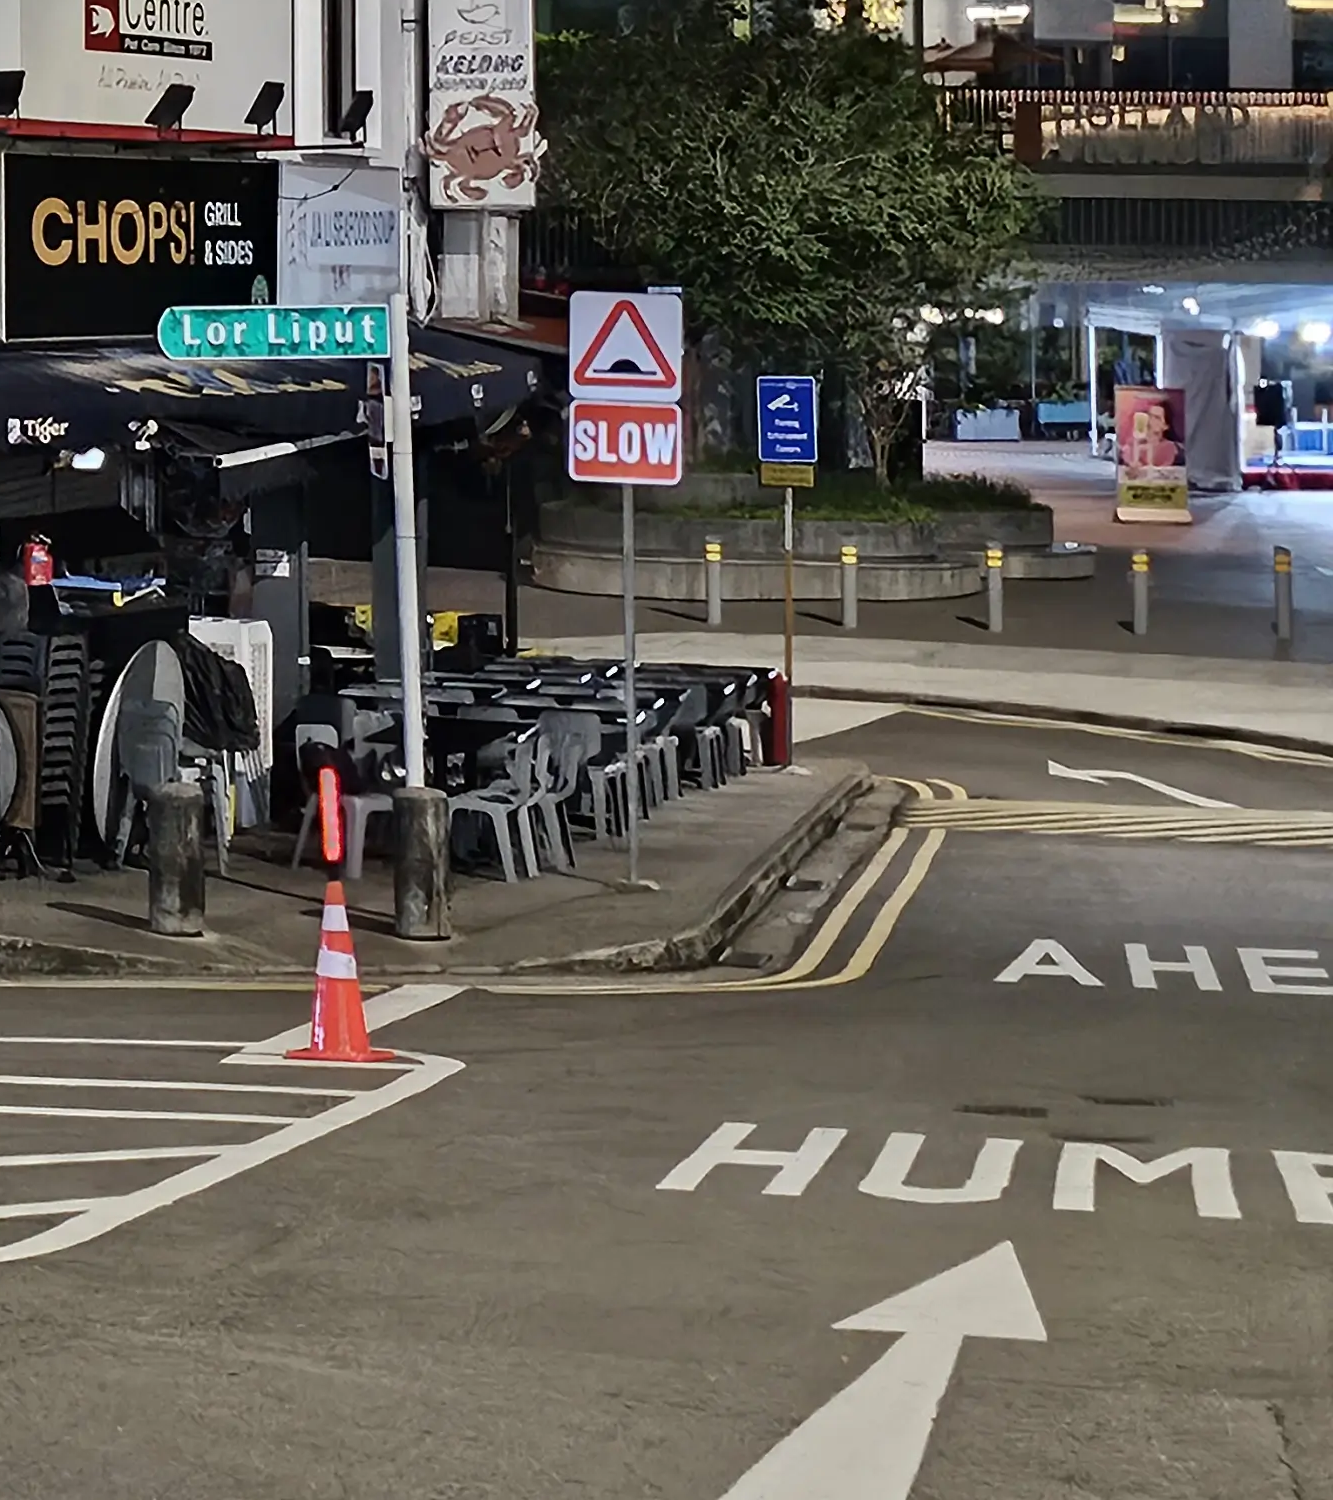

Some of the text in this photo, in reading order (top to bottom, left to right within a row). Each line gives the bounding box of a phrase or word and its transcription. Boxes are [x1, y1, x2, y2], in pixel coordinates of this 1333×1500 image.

[204, 202, 242, 226] GRILL
[31, 197, 195, 266] CHOPS!
[204, 240, 254, 266] & SIDES
[183, 312, 376, 351] Lor Liput
[24, 416, 69, 444] Tiger
[574, 420, 676, 466] SLOW
